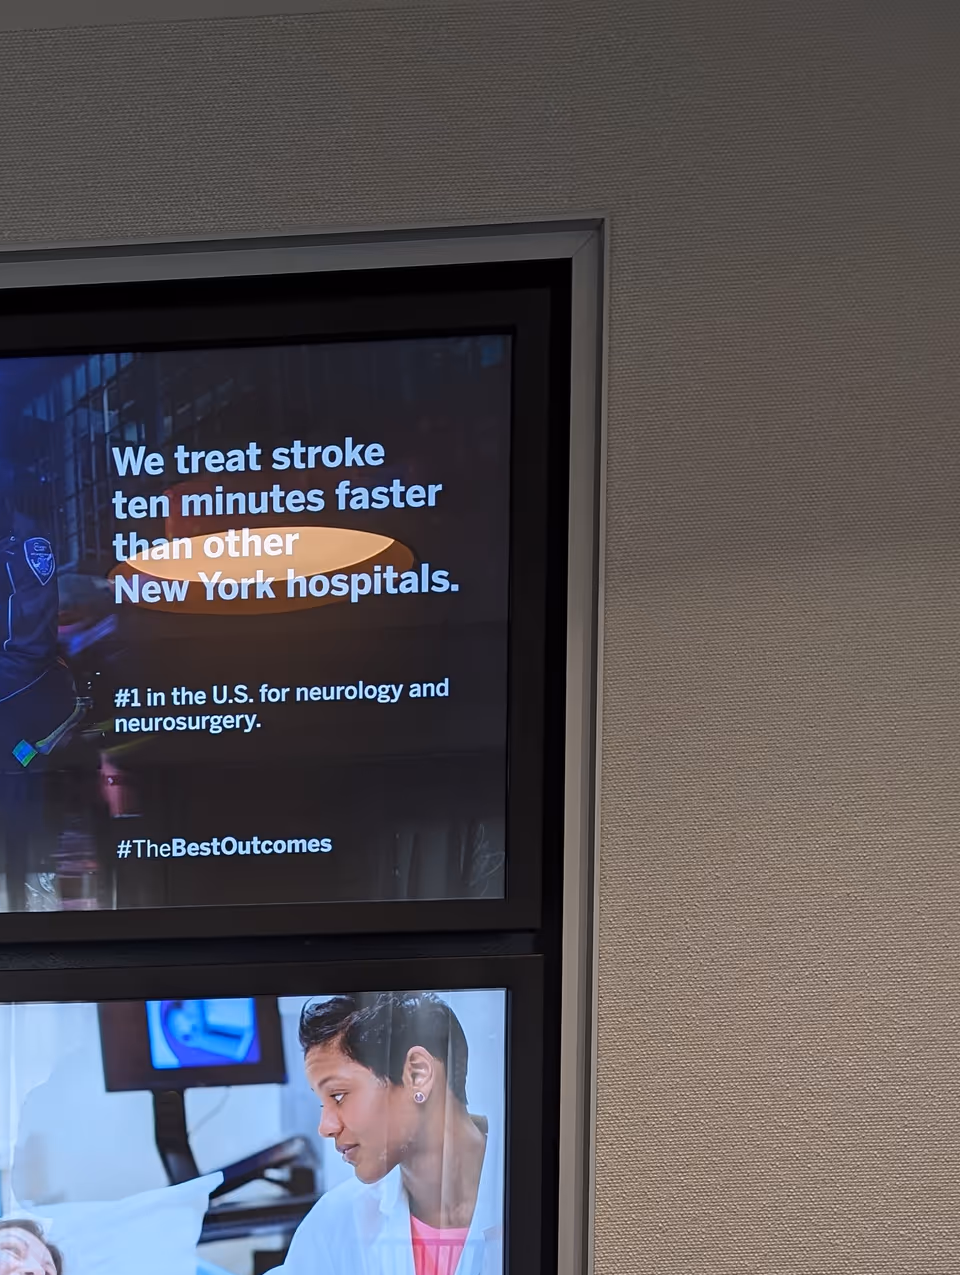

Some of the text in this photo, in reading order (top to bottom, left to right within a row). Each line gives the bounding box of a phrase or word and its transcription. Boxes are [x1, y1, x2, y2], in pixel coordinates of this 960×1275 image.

[112, 437, 385, 476] We treat stroke
[112, 479, 442, 519] ten minutes faster
[113, 528, 299, 562] than other
[114, 563, 459, 603] New York hospitals.
[114, 678, 449, 708] #1 in the U.S. for neurology and
[114, 713, 261, 734] neurosurgery.
[117, 836, 332, 858] #TheBestOutcomes
